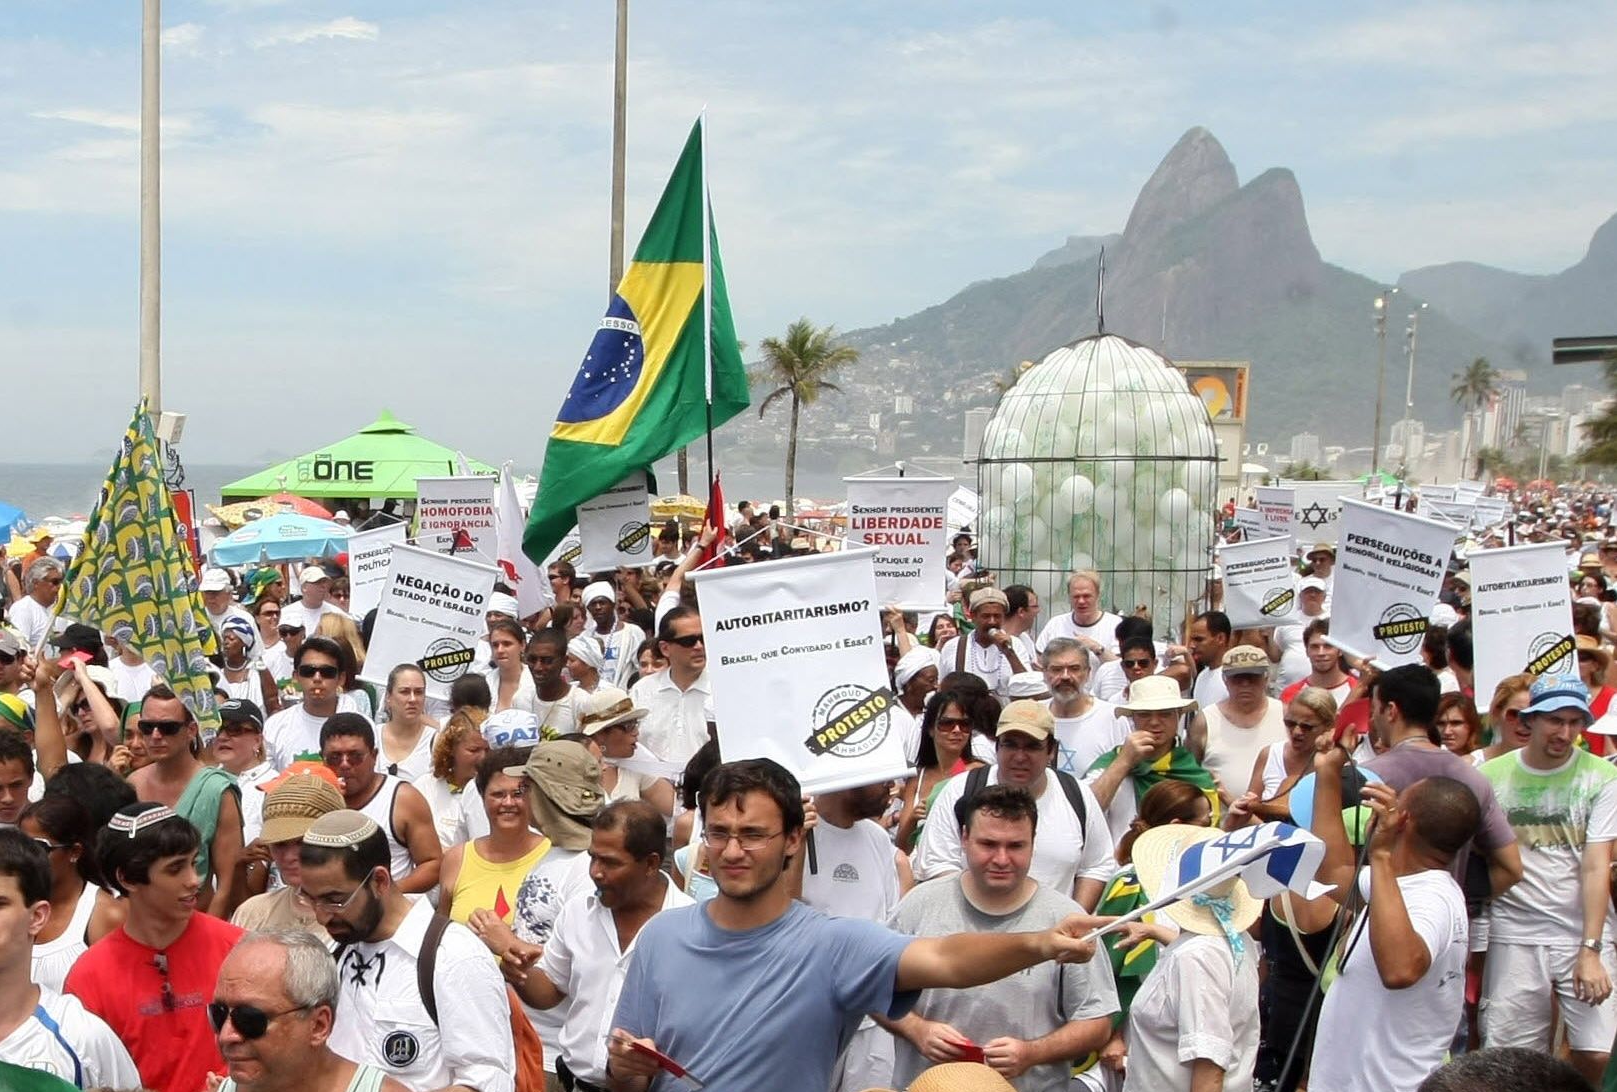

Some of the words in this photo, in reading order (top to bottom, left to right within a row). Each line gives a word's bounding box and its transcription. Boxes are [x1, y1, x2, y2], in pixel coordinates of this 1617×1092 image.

[420, 507, 493, 517] HOMOFOBIA
[852, 516, 943, 530] LIBERDADE
[864, 532, 930, 545] SEXUAL.
[1347, 533, 1433, 564] PERSEGUIÇÕES
[1435, 558, 1442, 568] A
[393, 588, 427, 602] ESTADO
[429, 597, 441, 606] DE
[443, 601, 481, 616] ISRAEL?
[396, 573, 460, 598] NEGAÇÃO
[464, 591, 484, 604] DO
[716, 600, 870, 632] AUTORITARITARISMO?
[1379, 621, 1425, 636] PROTESTO
[424, 652, 471, 668] PROTESTO
[1530, 640, 1572, 675] PROTESTO
[819, 689, 862, 716] MAHMOUD
[816, 695, 887, 747] PROTESTO
